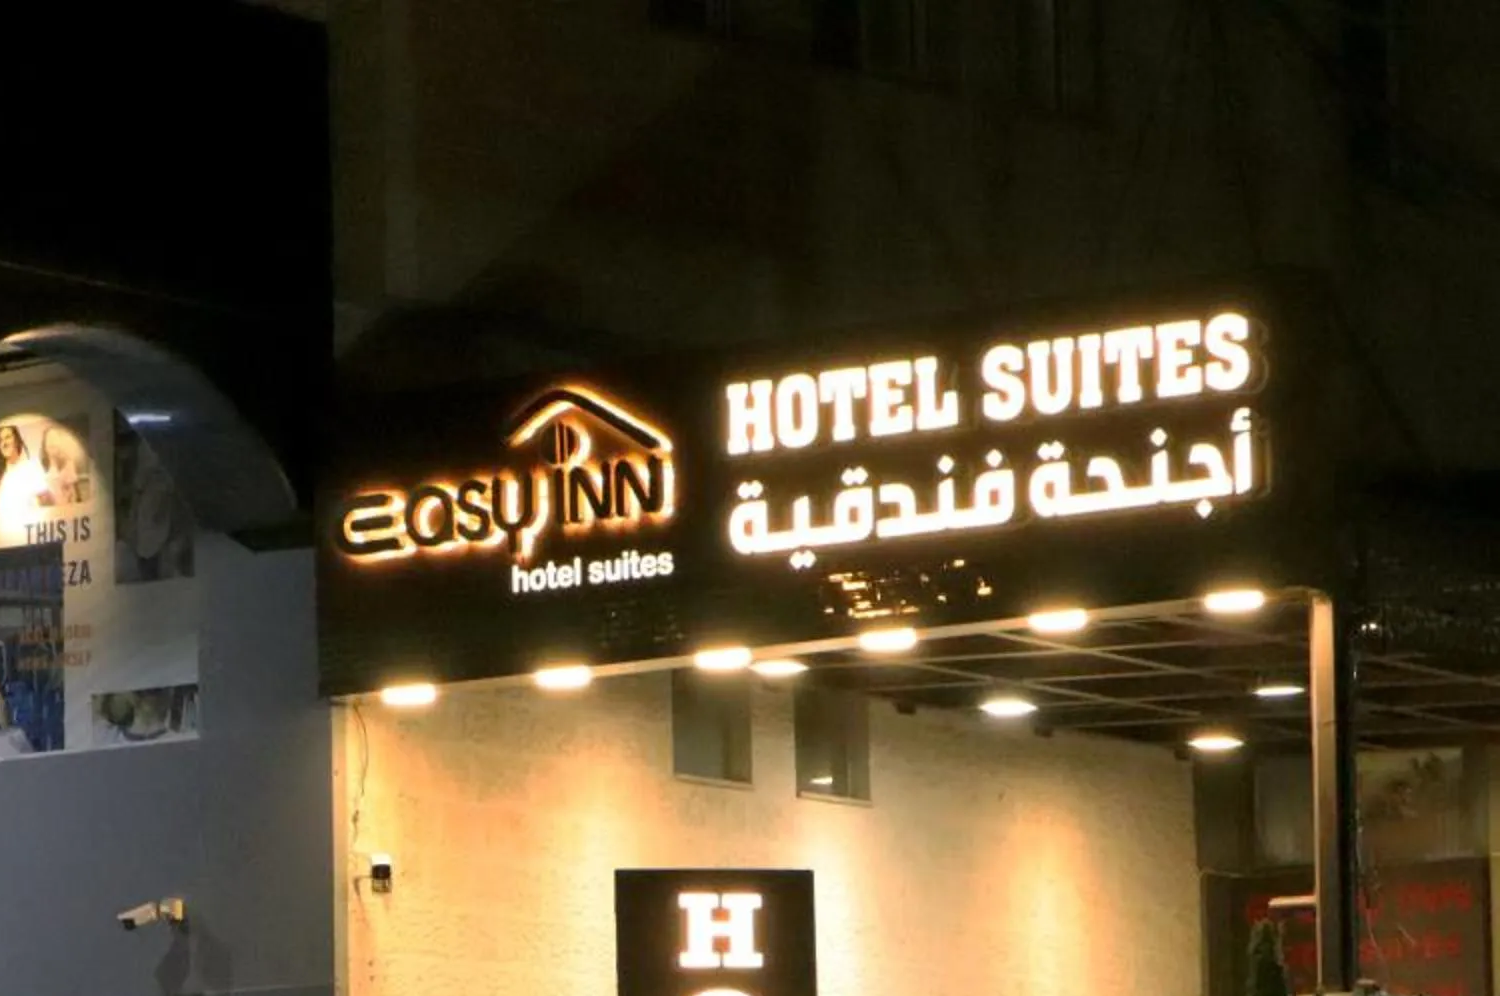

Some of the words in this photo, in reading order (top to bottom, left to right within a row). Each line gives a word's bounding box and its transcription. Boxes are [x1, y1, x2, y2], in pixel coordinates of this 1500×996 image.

[725, 355, 959, 456] HOTEL
[981, 312, 1251, 422] SUITES
[729, 448, 1016, 570] فندقية
[1029, 406, 1253, 519] أجنحة
[24, 519, 67, 545] THIS
[72, 516, 91, 543] IS
[511, 555, 582, 594] hotel
[588, 550, 675, 585] suites
